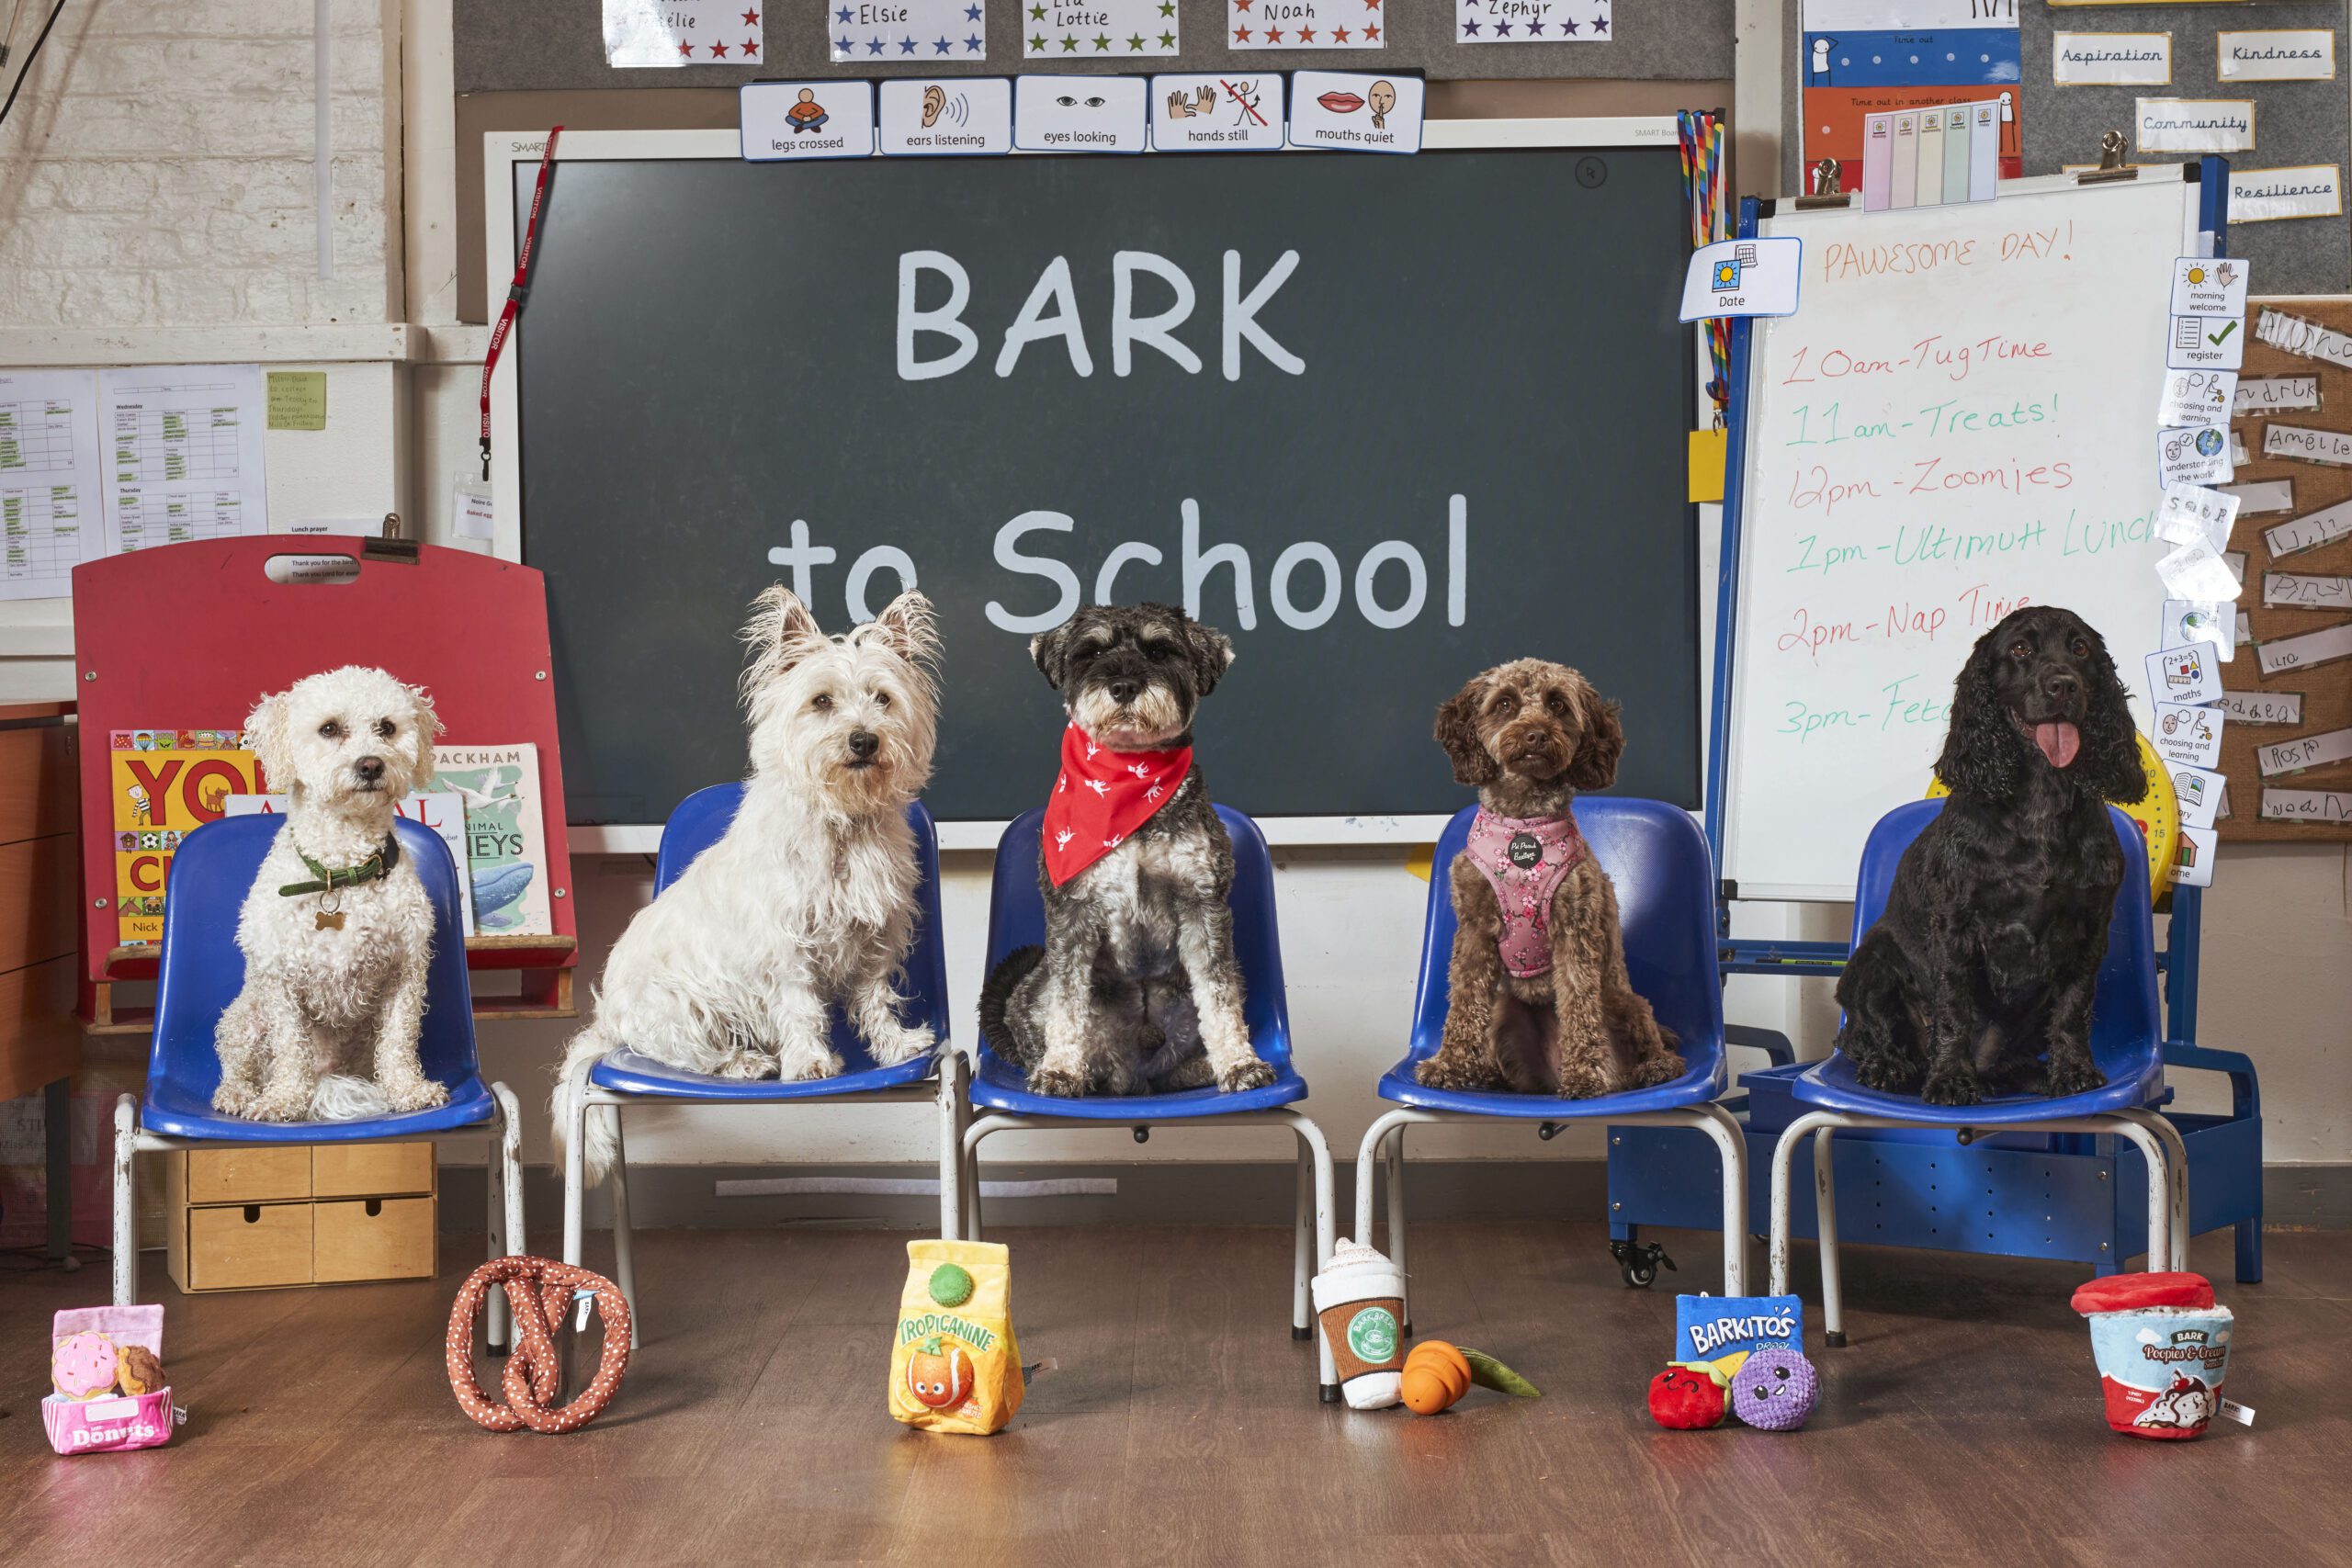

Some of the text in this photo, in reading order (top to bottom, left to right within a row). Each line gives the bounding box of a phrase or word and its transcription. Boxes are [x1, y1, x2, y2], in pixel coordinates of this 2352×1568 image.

[860, 5, 910, 25] Elsie
[1264, 3, 1316, 20] Noah
[1488, 0, 1553, 18] Zephyr
[1057, 11, 1110, 27] Lottie
[1894, 35, 1934, 44] Time out
[2061, 49, 2163, 66] Aspiration
[2233, 46, 2323, 60] Kindness
[1851, 97, 1873, 107] Time
[1876, 97, 1891, 107] out
[1895, 97, 1905, 106] in
[1909, 96, 1945, 106] another
[2143, 116, 2248, 133] Community
[906, 133, 986, 148] ears listening
[1044, 130, 1117, 146] eyes looking
[1188, 129, 1249, 142] hands still
[1315, 128, 1395, 144] mouths quiet
[772, 136, 844, 152] legs crossed
[2233, 183, 2333, 200] Resilience
[530, 186, 544, 220] VISITOR
[519, 236, 533, 269] VISITOR
[1824, 220, 2073, 283] PAWESOME DAY!
[1719, 296, 1746, 308] Date
[2190, 291, 2225, 302] morning
[897, 249, 1306, 380] BARK
[2188, 303, 2227, 312] welcome
[491, 318, 509, 351] VISITOR
[2187, 350, 2223, 362] register
[481, 366, 491, 398] VISITOR
[2169, 400, 2222, 413] choosing and
[481, 412, 491, 438] VISITO
[2178, 412, 2211, 425] learning
[2177, 469, 2215, 482] the world
[768, 493, 1467, 634] to School
[2173, 689, 2202, 703] maths
[2159, 737, 2211, 751] choosing and
[2168, 749, 2199, 762] learning
[2177, 808, 2192, 820] ory
[2154, 827, 2165, 839] 15
[2169, 867, 2191, 878] ome
[132, 921, 158, 932] Nick
[898, 1314, 995, 1353] TROPICANINE
[1689, 1314, 1796, 1355] BARKITOS
[2177, 1332, 2205, 1342] BARK
[2143, 1345, 2225, 1363] Poopies & Cream
[73, 1424, 155, 1448] Donuts
